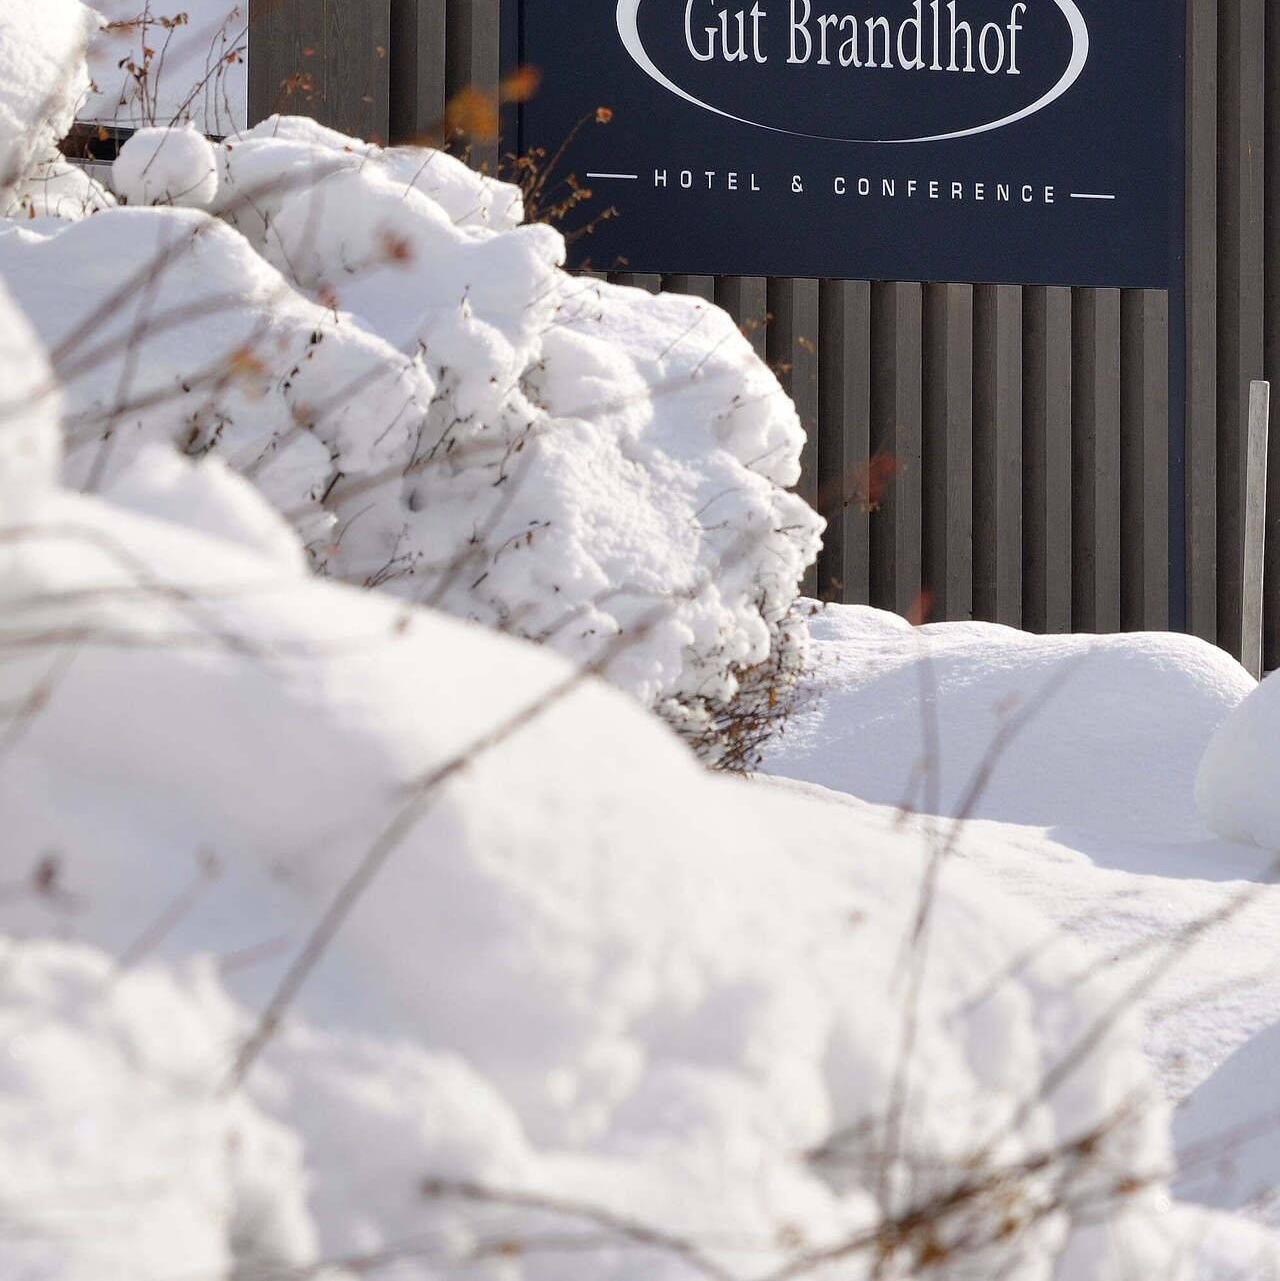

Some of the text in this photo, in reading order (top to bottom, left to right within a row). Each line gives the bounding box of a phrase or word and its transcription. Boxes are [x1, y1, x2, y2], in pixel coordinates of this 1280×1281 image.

[653, 168, 1056, 205] HOTEL & CONFERENCE
